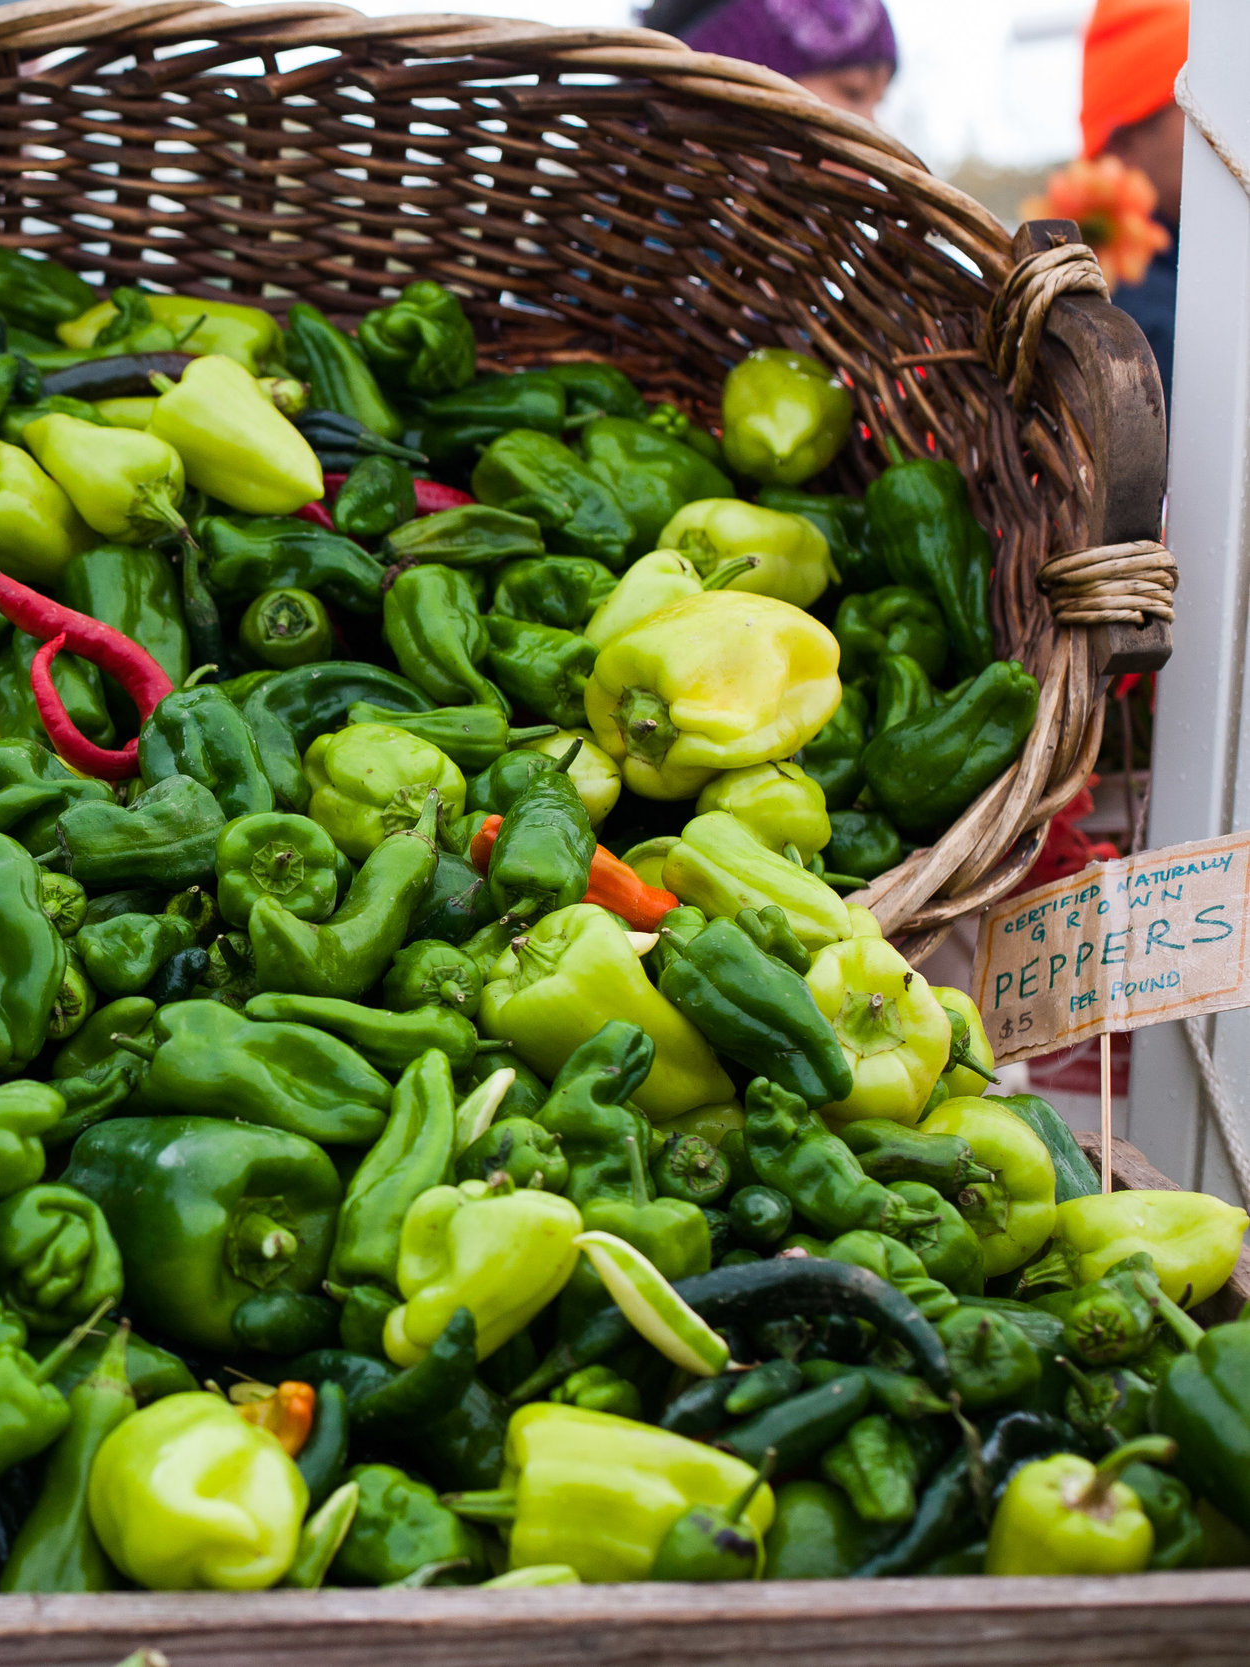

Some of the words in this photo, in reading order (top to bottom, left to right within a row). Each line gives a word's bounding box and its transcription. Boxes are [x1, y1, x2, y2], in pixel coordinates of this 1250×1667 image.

[1004, 885, 1100, 933] CERTIFIED
[1116, 852, 1233, 893] NATURALLY
[994, 905, 1234, 1010] PEPPERS
[1000, 1011, 1033, 1039] $5
[1070, 989, 1098, 1013] PER
[1111, 970, 1180, 1001] POUND
